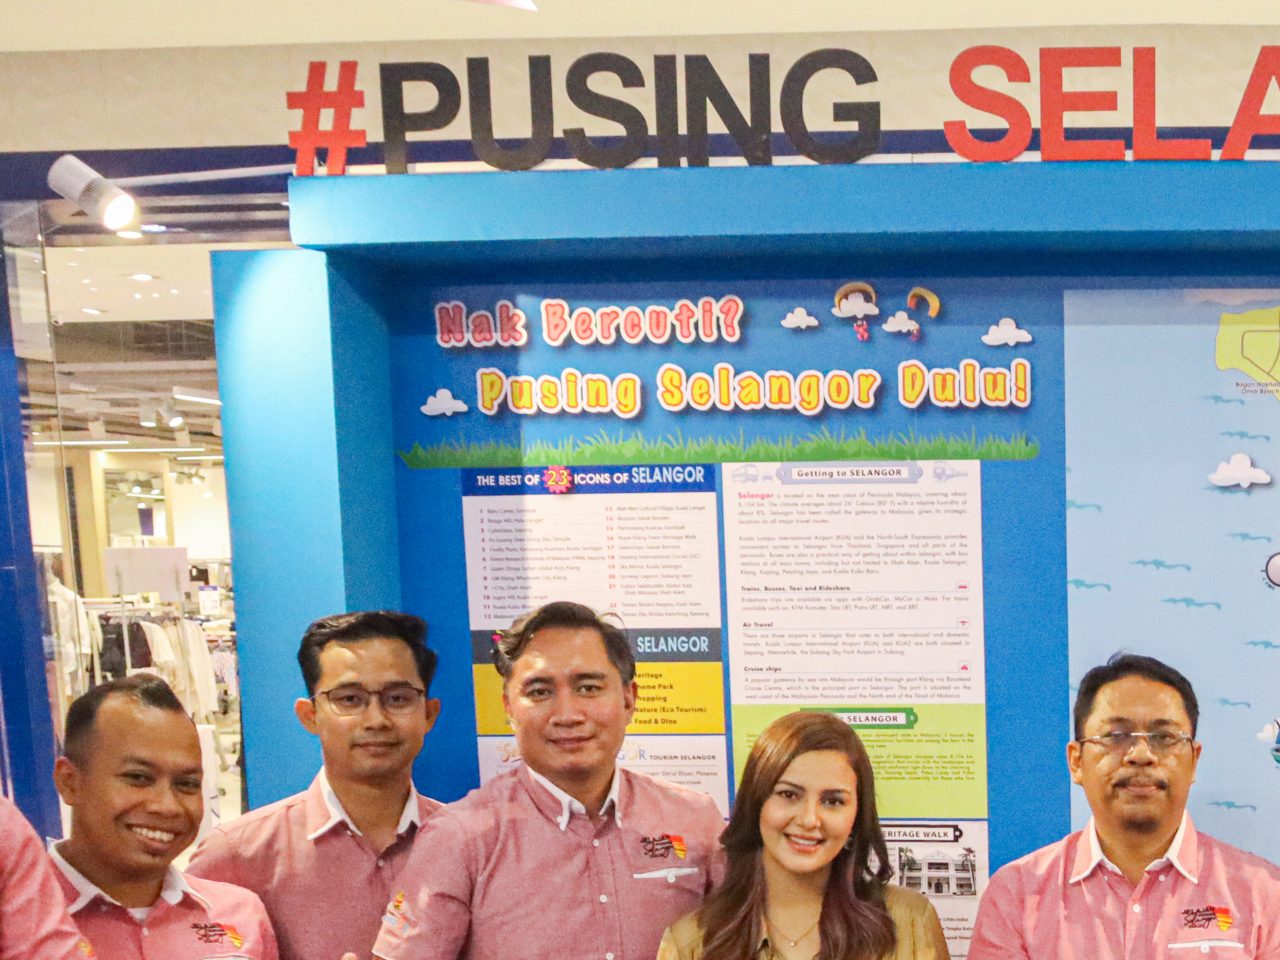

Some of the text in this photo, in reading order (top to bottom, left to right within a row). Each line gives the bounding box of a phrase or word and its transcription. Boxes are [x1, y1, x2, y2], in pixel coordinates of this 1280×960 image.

[286, 47, 882, 176] #PUSING
[436, 295, 744, 347] Nak Bercuti?
[477, 358, 1033, 417] Pusing Selangor Dulu!
[477, 466, 705, 486] THE BEST OF 23 ICONS OF SELANGOR
[797, 468, 902, 481] Getting to SELANGOR
[637, 636, 710, 653] SELANGOR
[636, 673, 663, 682] eritage
[637, 695, 667, 703] hopping
[847, 715, 899, 723] SELANGOR
[923, 830, 948, 838] WALK
